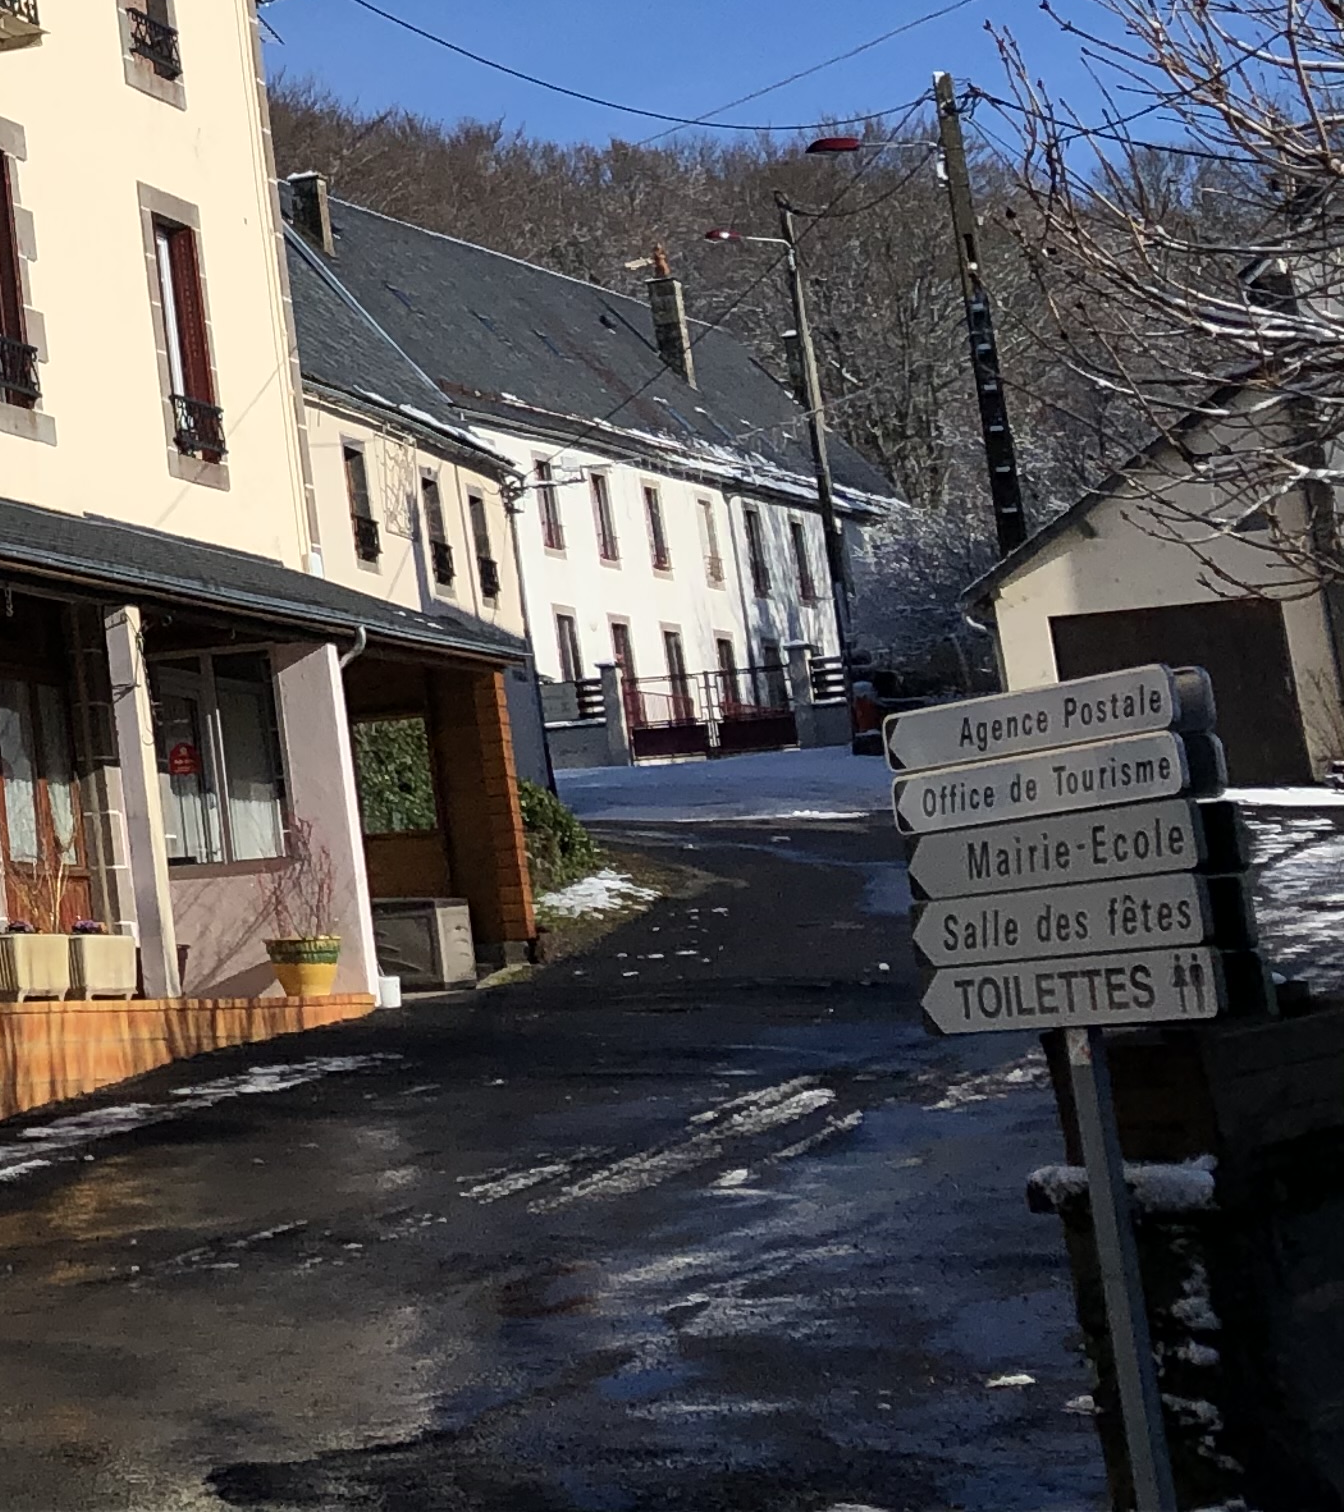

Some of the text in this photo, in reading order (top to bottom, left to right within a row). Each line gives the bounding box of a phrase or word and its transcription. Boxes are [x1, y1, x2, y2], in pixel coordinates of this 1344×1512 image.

[959, 683, 1163, 753] Agence Postale
[922, 756, 1172, 818] Office de Tourisme
[967, 817, 1185, 881] Mairie-Ecole
[943, 894, 1192, 951] Salle des fêtes
[953, 963, 1157, 1021] TOILETTES
